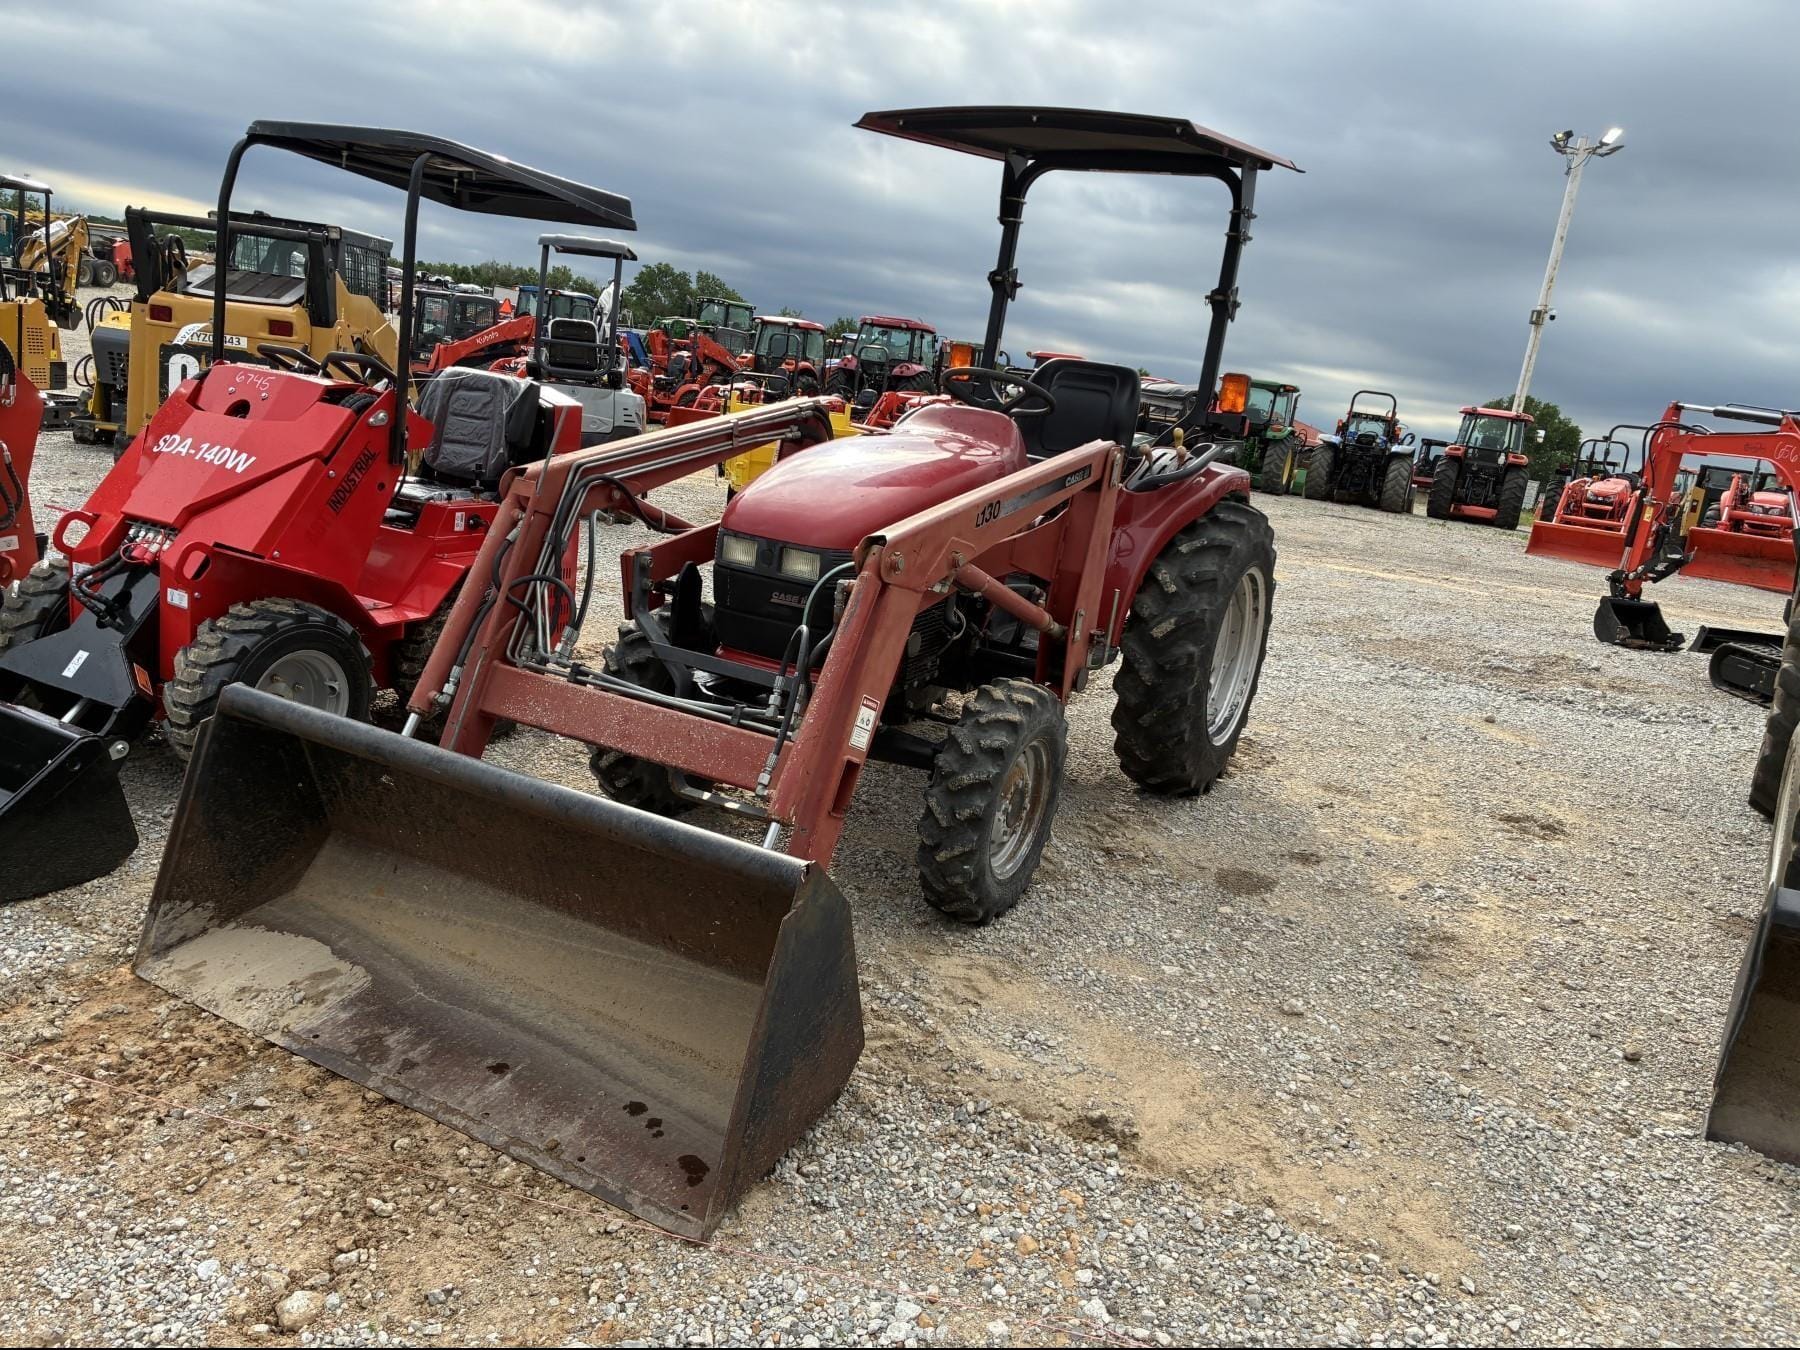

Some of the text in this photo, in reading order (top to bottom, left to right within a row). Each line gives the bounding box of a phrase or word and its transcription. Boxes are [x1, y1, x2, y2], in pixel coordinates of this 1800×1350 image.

[236, 371, 276, 391] 6745
[153, 434, 256, 474] SDA-140W
[327, 443, 378, 514] INDUSTRIAL
[975, 500, 1001, 528] L130
[772, 592, 799, 603] CASE
